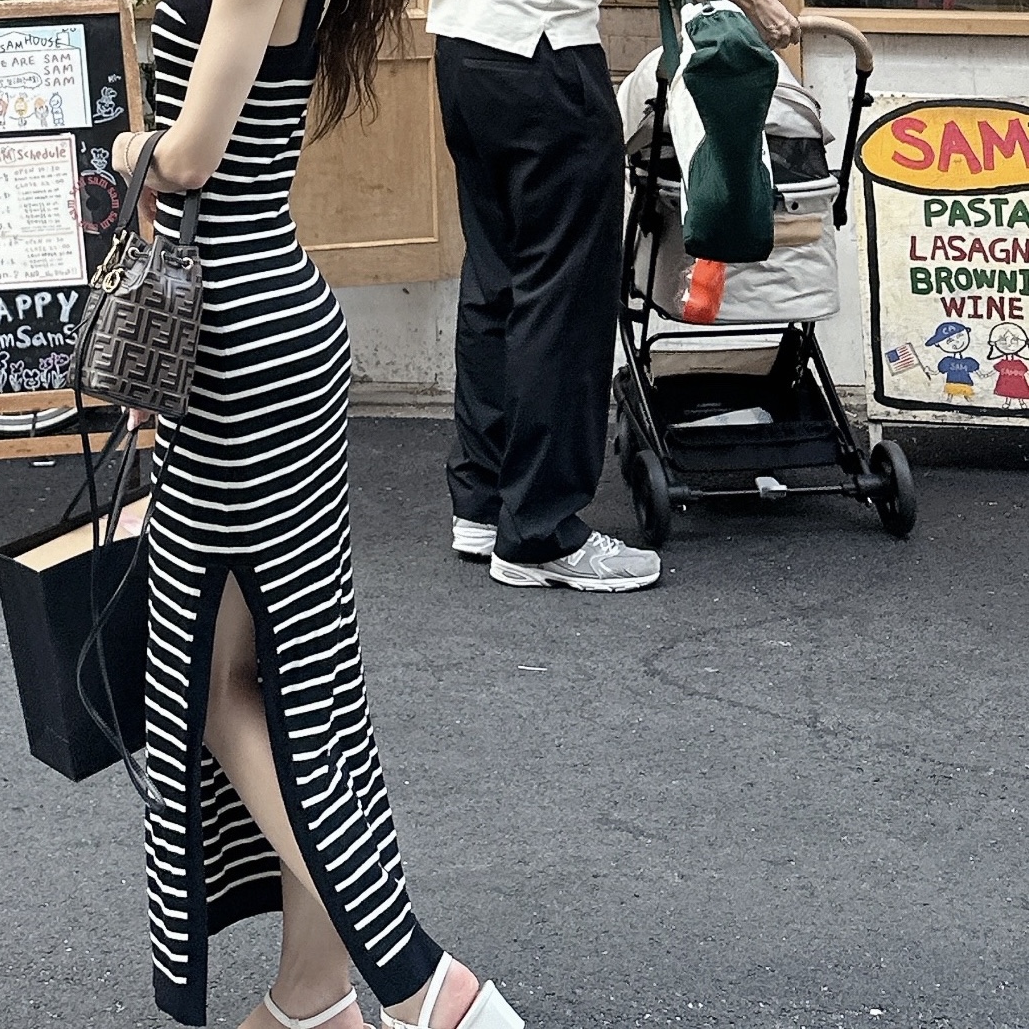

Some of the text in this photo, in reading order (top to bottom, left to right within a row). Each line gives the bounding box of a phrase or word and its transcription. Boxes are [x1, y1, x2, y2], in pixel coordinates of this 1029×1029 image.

[11, 55, 35, 68] ARE
[44, 53, 71, 64] SAM
[43, 64, 73, 75] SAM
[44, 76, 75, 87] SAM
[17, 145, 67, 161] Schedule
[892, 117, 1029, 174] SAM
[87, 176, 109, 189] sam
[107, 186, 120, 209] sam
[100, 210, 119, 230] sam
[924, 197, 1029, 229] PASTA
[940, 296, 1024, 321] WINE
